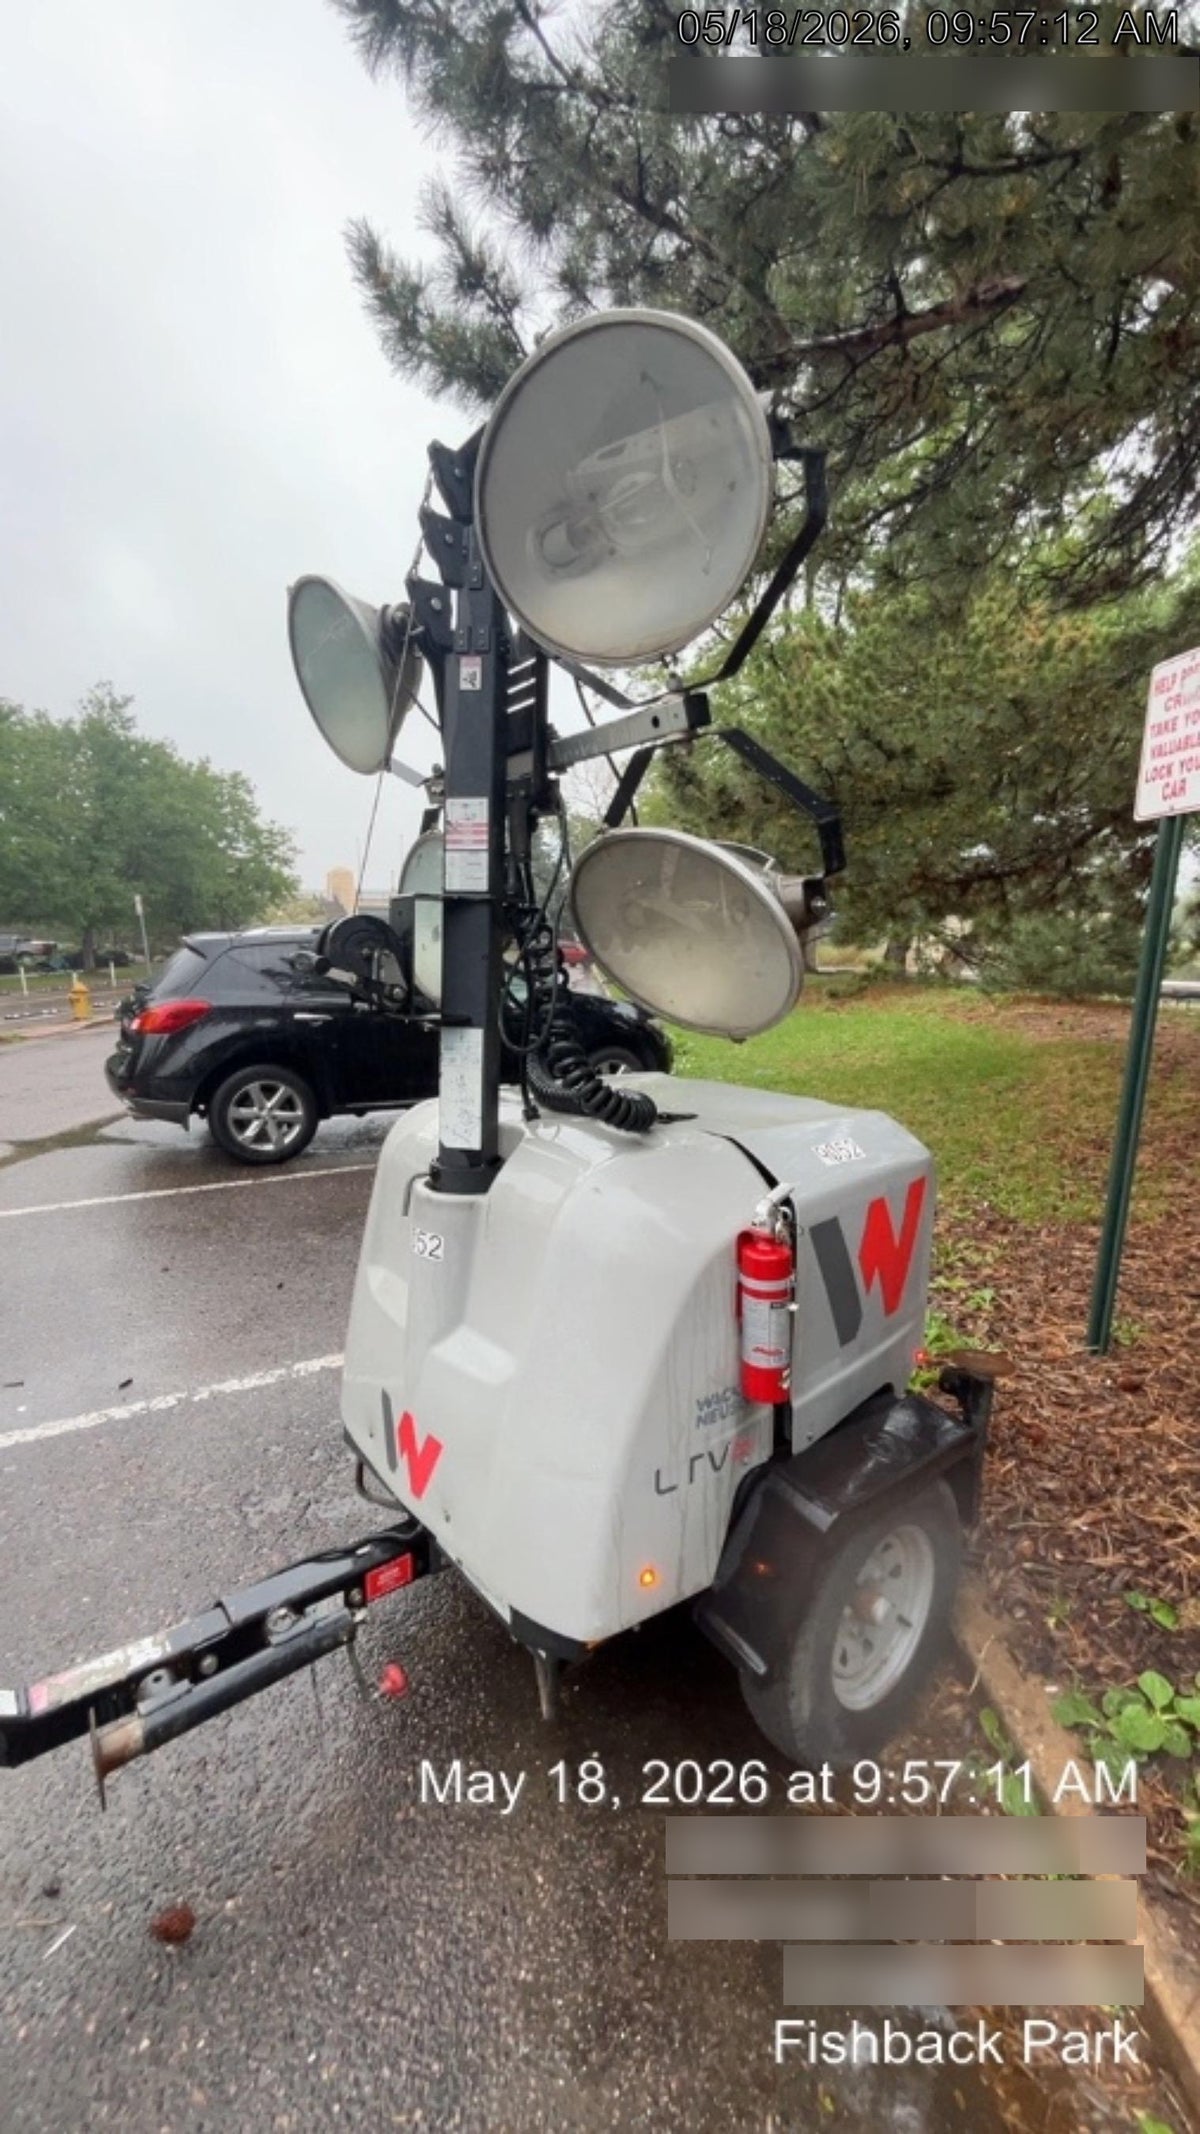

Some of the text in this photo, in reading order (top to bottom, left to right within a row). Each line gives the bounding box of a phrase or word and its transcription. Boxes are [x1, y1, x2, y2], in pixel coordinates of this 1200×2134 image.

[1150, 715, 1178, 738] TAKE
[1145, 761, 1174, 783] LOCK
[1162, 777, 1187, 801] CAR
